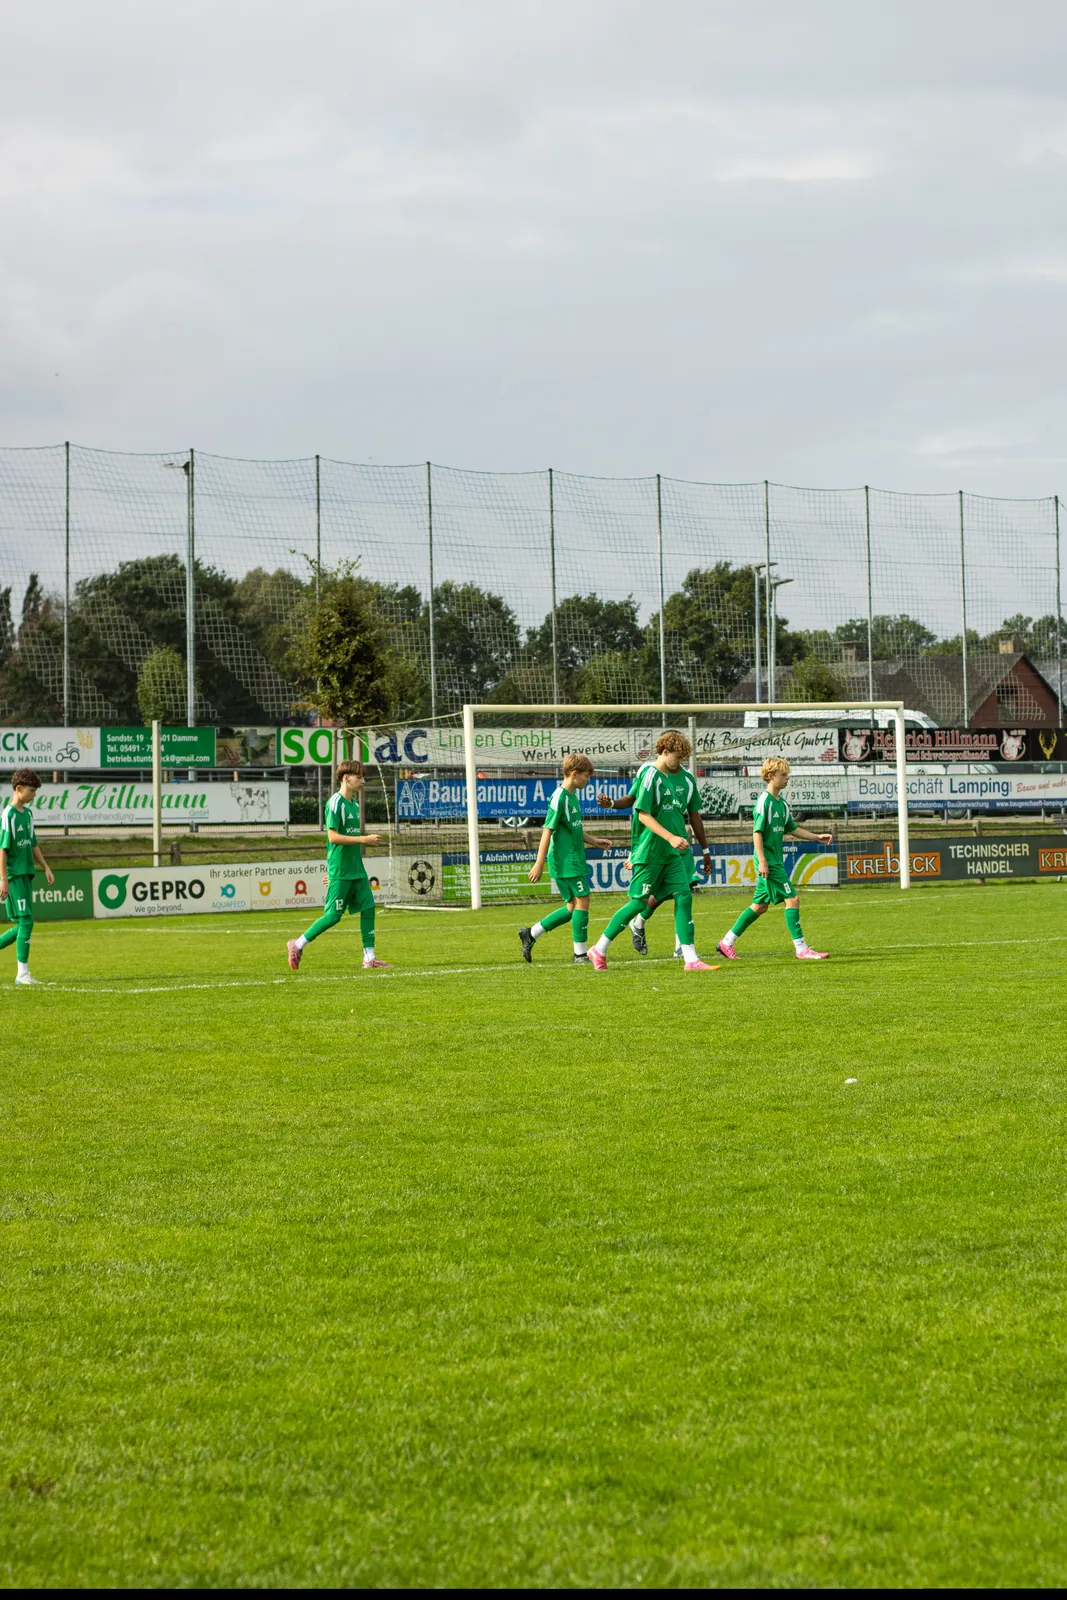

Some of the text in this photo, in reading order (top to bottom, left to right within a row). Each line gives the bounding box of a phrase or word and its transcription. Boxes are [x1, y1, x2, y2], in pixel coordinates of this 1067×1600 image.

[0, 732, 52, 752] CK GbR
[106, 734, 134, 742] Sandstr.
[136, 734, 144, 742] 19
[172, 734, 198, 742] Damme
[439, 730, 552, 747] Linen GmbH
[697, 732, 716, 751] off
[794, 731, 834, 749] GmbH
[873, 730, 998, 747] Heirich Hillmann
[106, 744, 118, 753] Tel.
[120, 744, 140, 752] 05491
[522, 748, 557, 762] Werk
[429, 780, 527, 807] Baupanung
[533, 780, 551, 802] A.
[950, 778, 1009, 797] Lamping
[791, 791, 800, 800] 91
[802, 791, 816, 799] 592
[821, 791, 830, 799] 08
[63, 812, 81, 821] 1803
[485, 853, 514, 862] Abfahrt
[515, 852, 538, 861] Vecht
[602, 849, 612, 857] A7
[949, 843, 1030, 859] TECHNISCHER
[1041, 850, 1067, 868] KR
[209, 868, 221, 879] Ihr
[223, 868, 253, 878] starker
[254, 867, 286, 876] Partner
[287, 867, 303, 875] aus
[303, 864, 318, 874] der
[967, 860, 1013, 875] HANDEL
[131, 879, 206, 902] GEPRO
[576, 881, 584, 892] 3
[17, 899, 27, 912] 17
[211, 900, 246, 909] AQUAFEED
[285, 896, 316, 905] BIODIESEL
[335, 899, 344, 911] 12
[134, 903, 184, 914] We go beyond.
